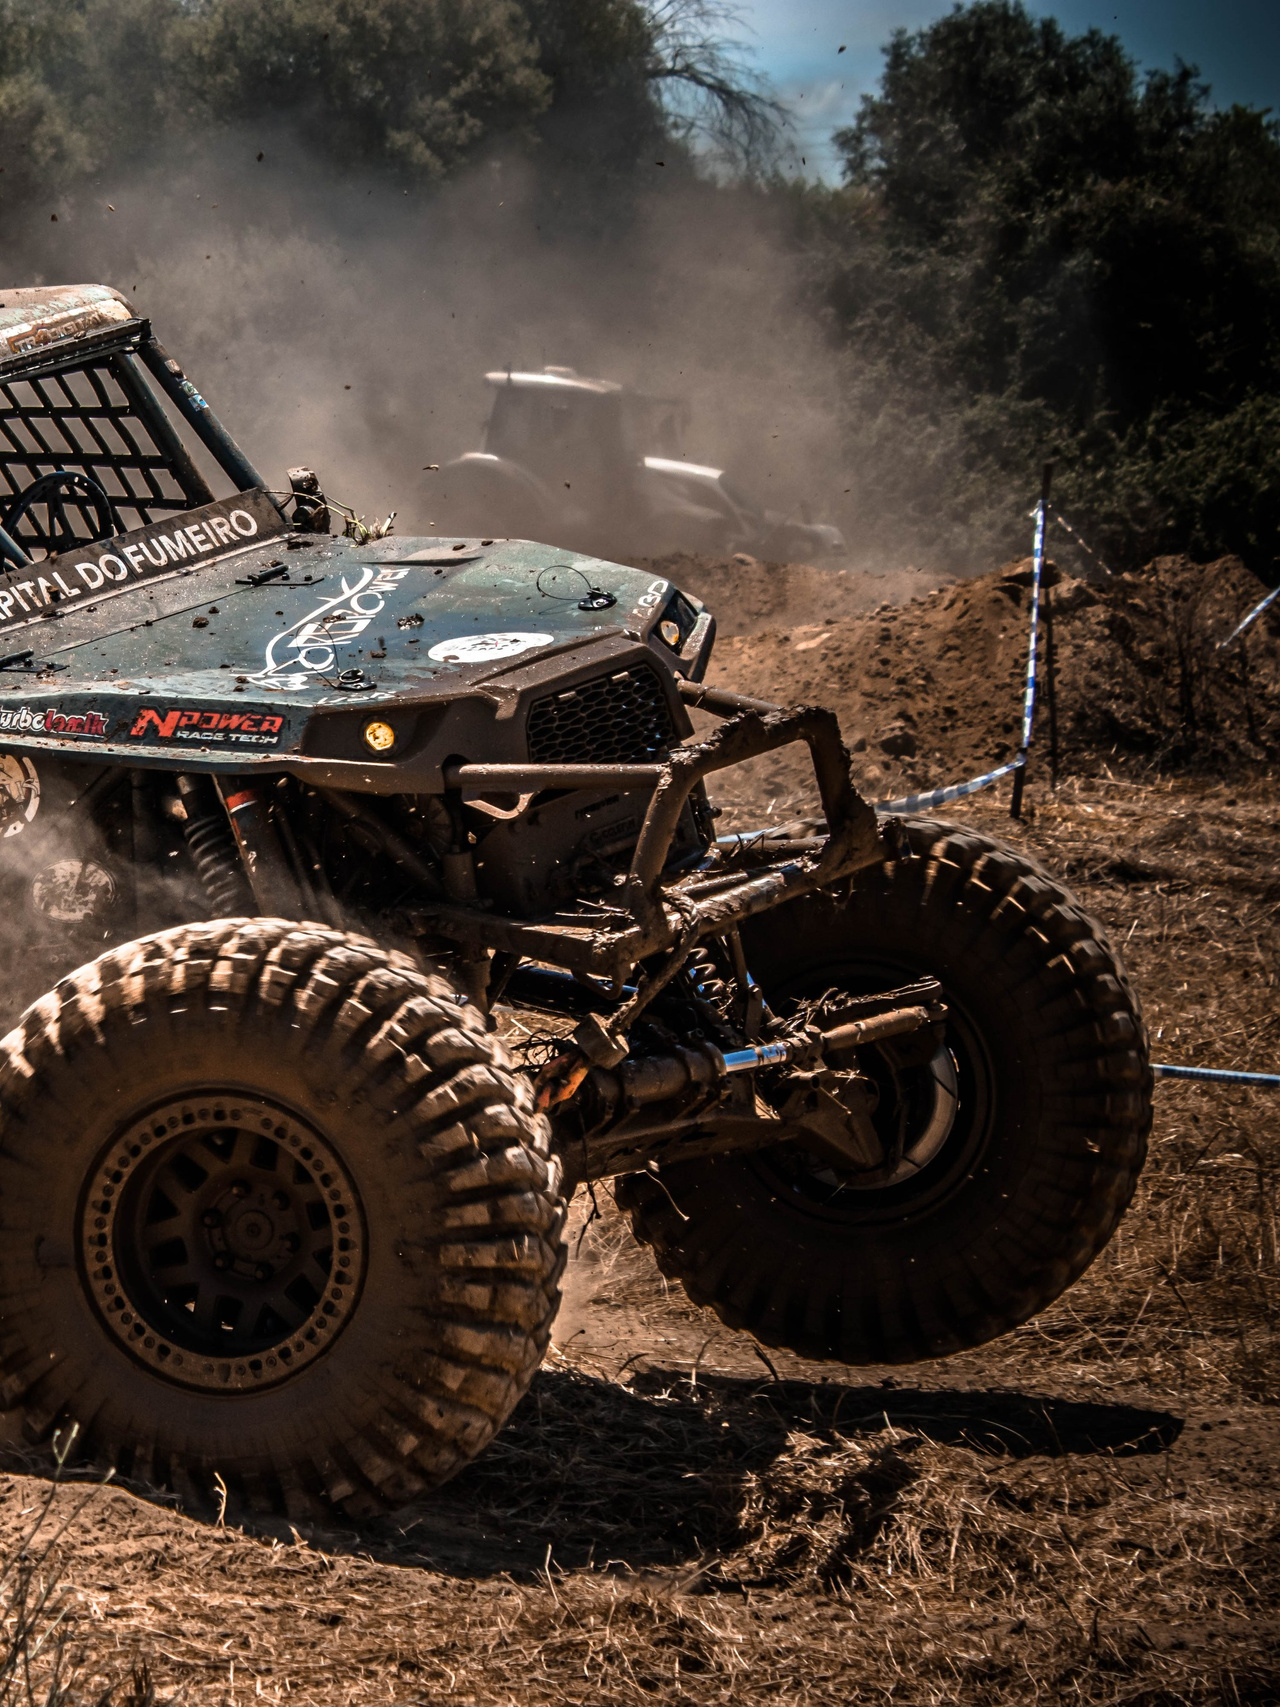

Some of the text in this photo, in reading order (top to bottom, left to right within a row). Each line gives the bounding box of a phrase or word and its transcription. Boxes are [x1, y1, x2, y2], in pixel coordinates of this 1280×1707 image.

[74, 553, 129, 591] DO
[127, 509, 260, 574] FUMEIRO
[175, 730, 280, 745] RACE TECH
